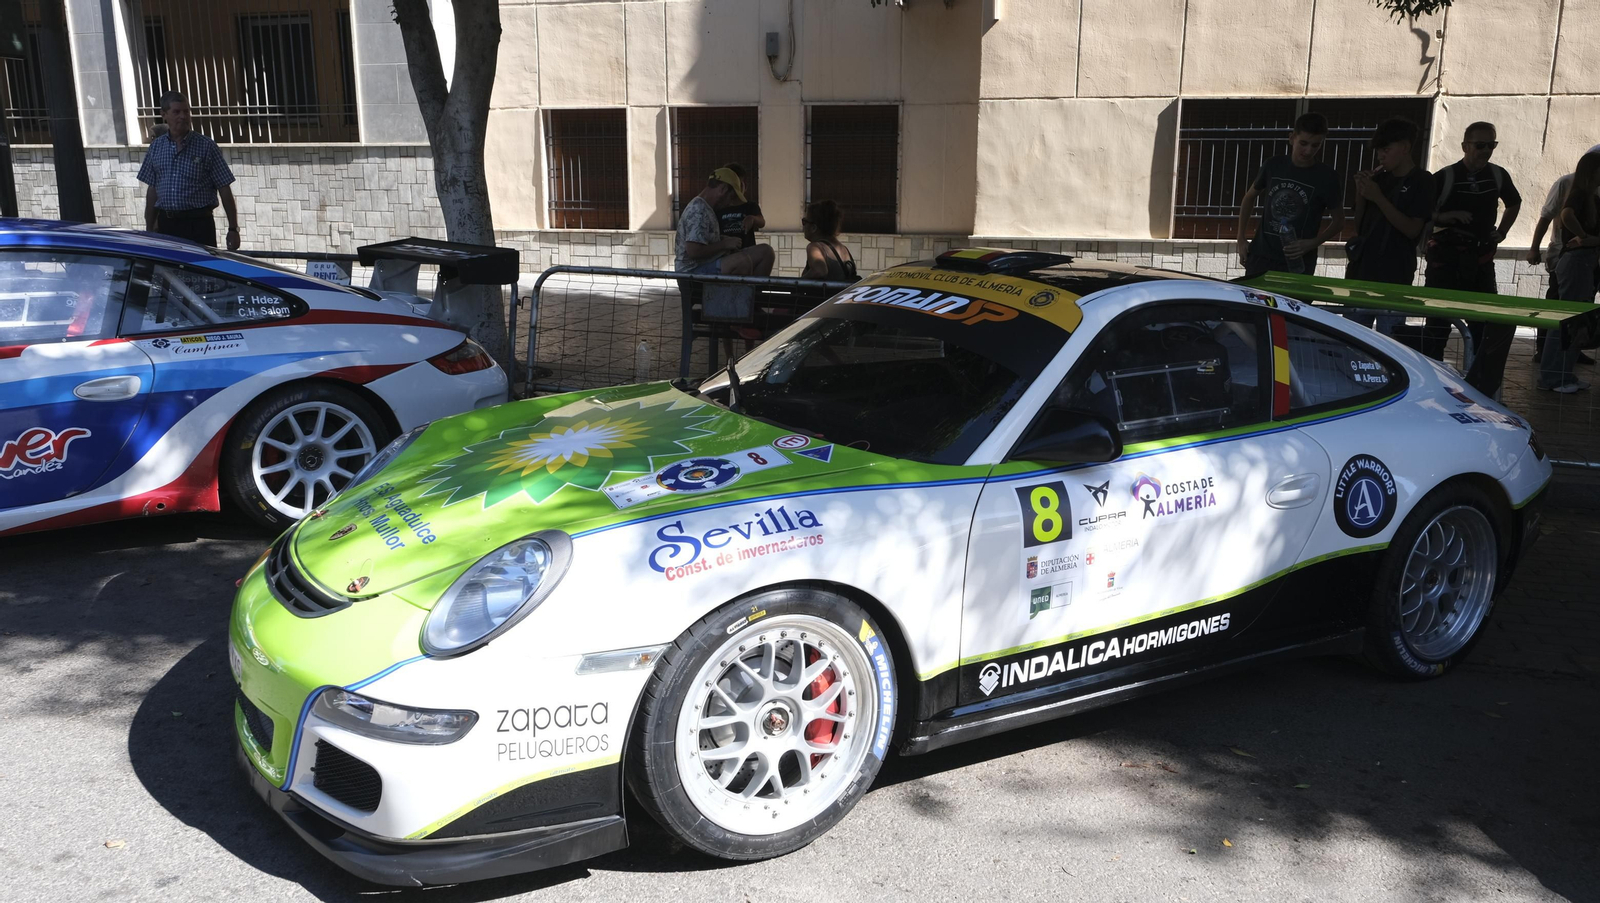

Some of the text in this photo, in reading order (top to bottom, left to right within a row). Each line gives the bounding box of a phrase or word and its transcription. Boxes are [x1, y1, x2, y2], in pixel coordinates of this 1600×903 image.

[313, 271, 342, 281] RENT
[933, 273, 959, 284] CLUB
[959, 276, 977, 287] DE
[237, 295, 281, 305] F. Hdez
[238, 305, 291, 318] C.H. Salom
[171, 341, 241, 355] Campinar
[253, 392, 303, 431] MICHELIN
[746, 452, 769, 465] 8
[1165, 476, 1215, 496] COSTA DE
[1336, 459, 1396, 498] LITTLE WARRIORS
[1030, 486, 1063, 543] 8
[1156, 489, 1217, 517] ALMERÍA
[1352, 479, 1377, 520] A
[368, 513, 406, 551] Mullor
[384, 492, 437, 545] Aguadulce
[1078, 511, 1127, 526] CUPRA
[648, 505, 823, 573] Sevilla
[664, 533, 825, 581] Const. de invernaderos
[1001, 612, 1231, 688] INDALICA HORMIGONES
[1393, 634, 1429, 674] MICHELIN
[496, 701, 609, 738] zapata
[874, 652, 893, 751] MICHELIN
[497, 733, 610, 762] PELUQUEROS
